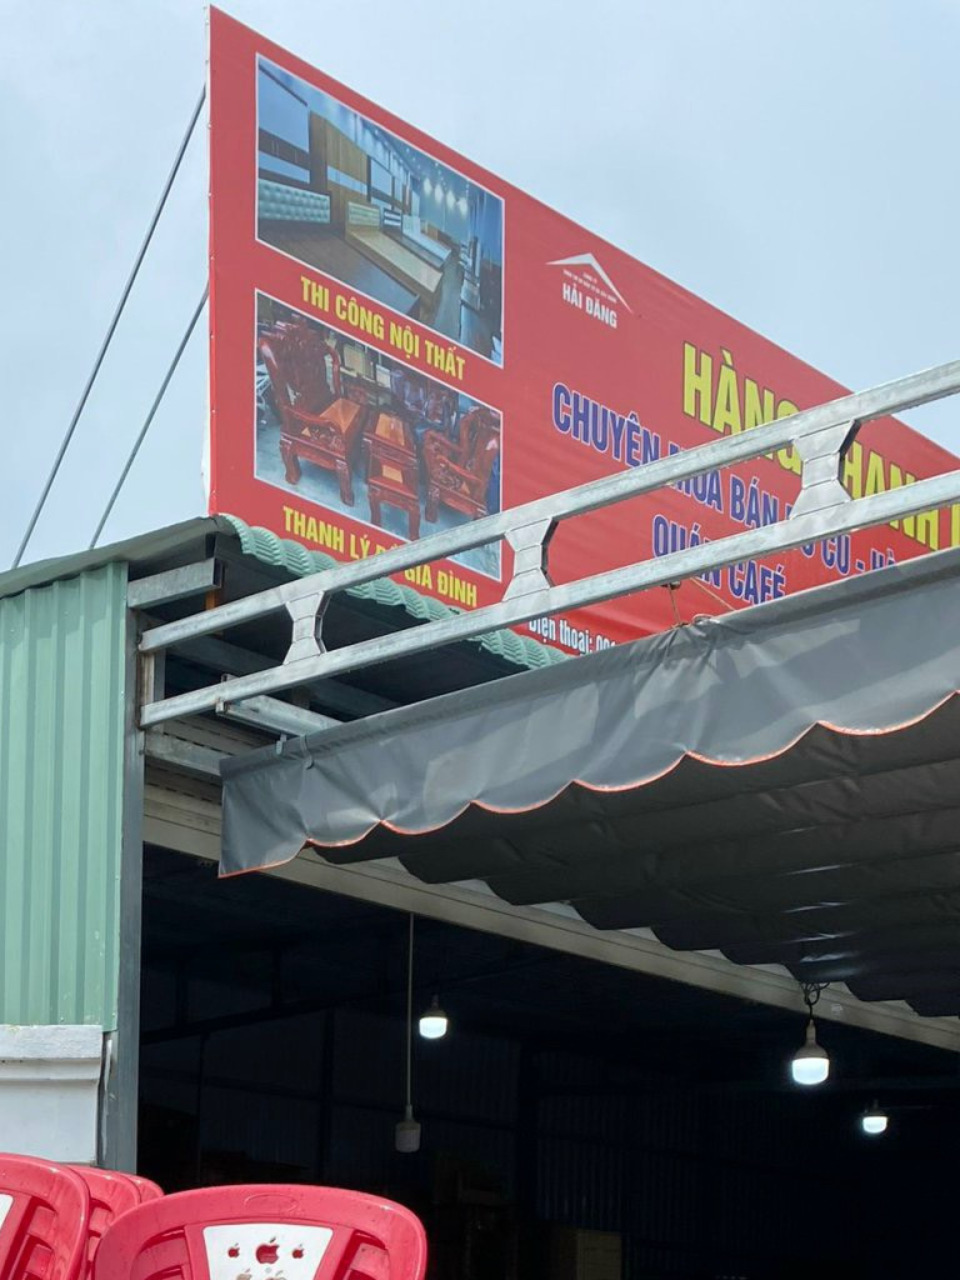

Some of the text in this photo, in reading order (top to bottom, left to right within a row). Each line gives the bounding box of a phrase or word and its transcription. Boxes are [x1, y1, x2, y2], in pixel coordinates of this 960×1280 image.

[301, 276, 466, 381] THI CÔNG NỘI THẤT
[563, 281, 582, 309] HẢI
[552, 381, 661, 468] CHUYÊN
[730, 474, 779, 529] BÁN
[283, 506, 345, 553] THANH
[350, 534, 371, 561] LÝ
[404, 564, 433, 590] GIA
[437, 570, 477, 608] ĐÌNH
[727, 559, 786, 605] CAFÉ
